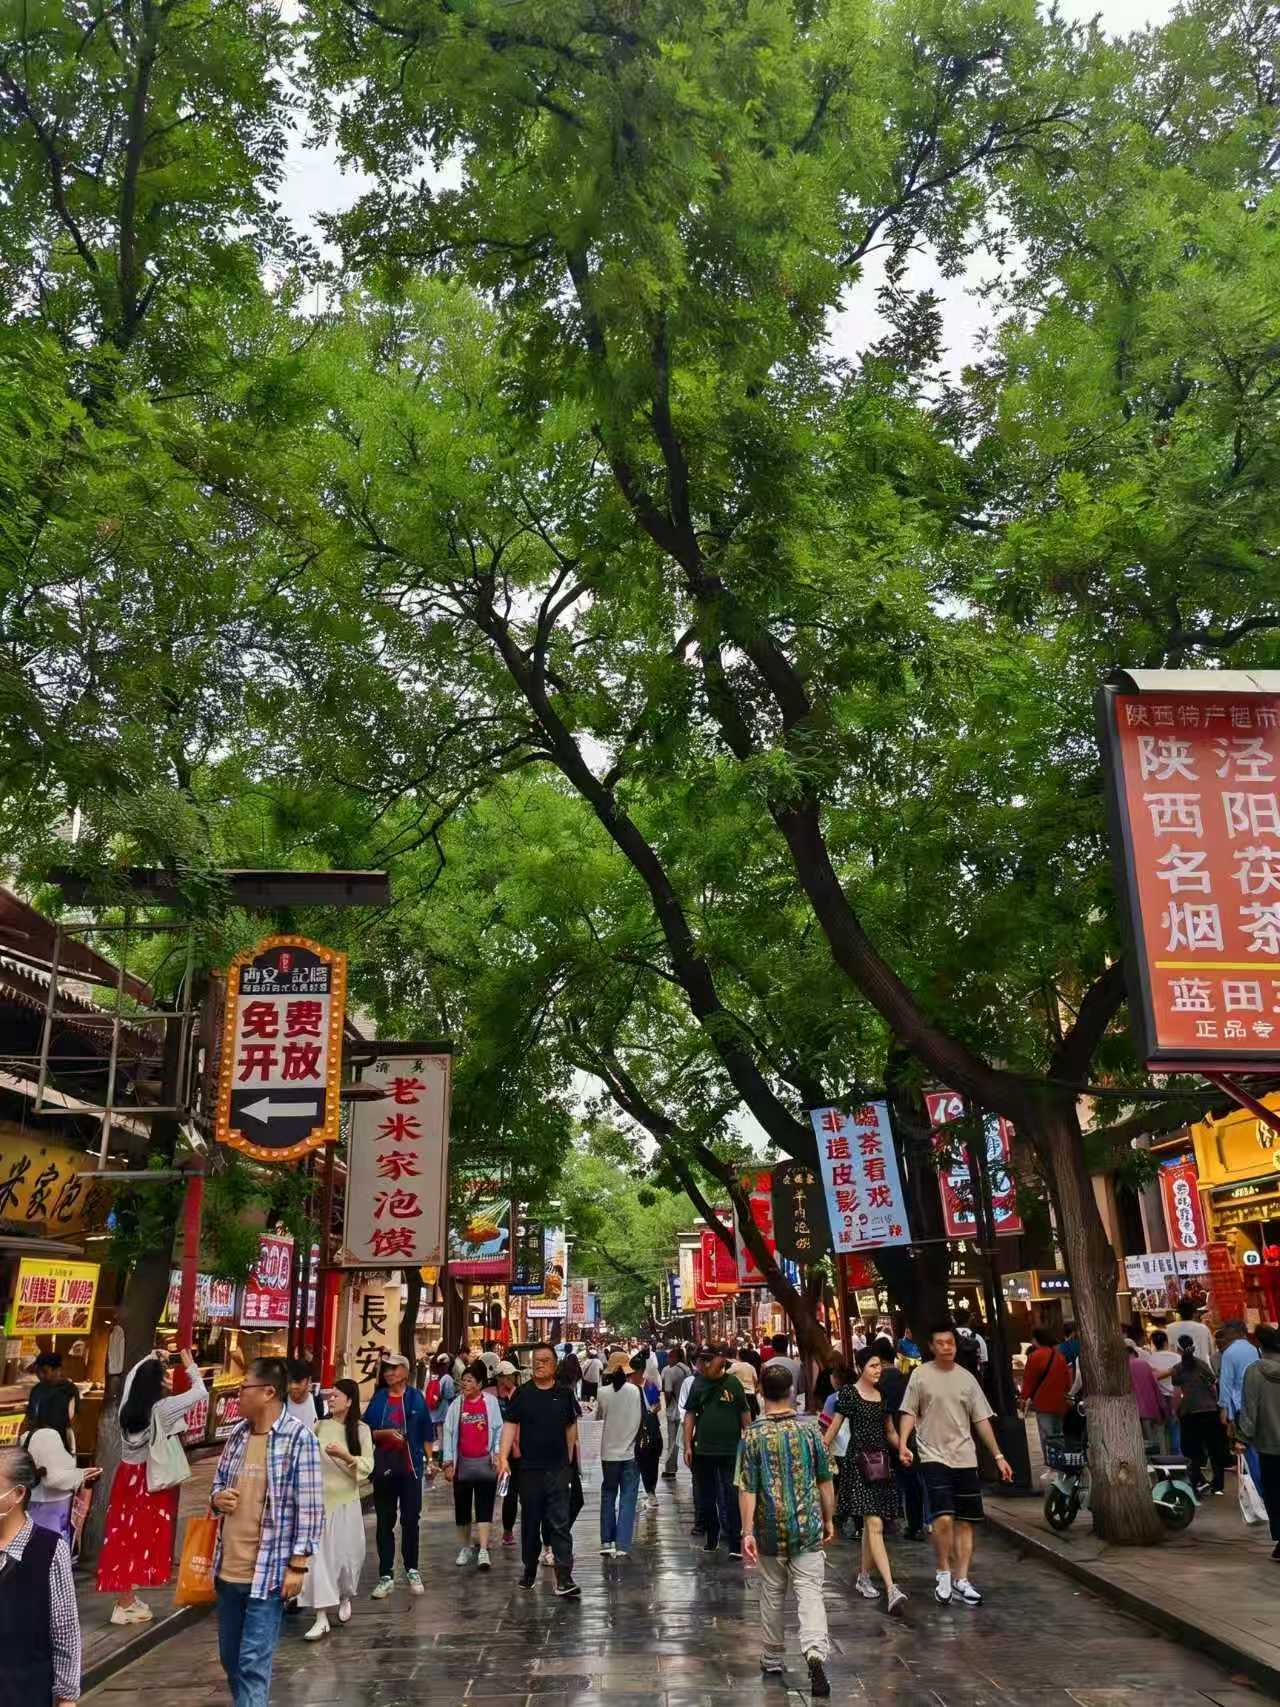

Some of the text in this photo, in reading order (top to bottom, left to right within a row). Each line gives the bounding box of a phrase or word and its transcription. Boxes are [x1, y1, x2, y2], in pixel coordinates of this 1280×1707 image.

[1125, 703, 1280, 728] 陕西特产超市
[1136, 734, 1224, 952] 陕西名烟
[1212, 735, 1280, 954] 泾阳茯茶
[238, 1042, 322, 1081] 开放
[241, 1000, 322, 1038] 免费
[1195, 1020, 1275, 1039] 正品专
[363, 1077, 427, 1258] 老米家泡馍
[853, 1105, 893, 1208] 喝茶看戏
[356, 1294, 391, 1384] 長安
